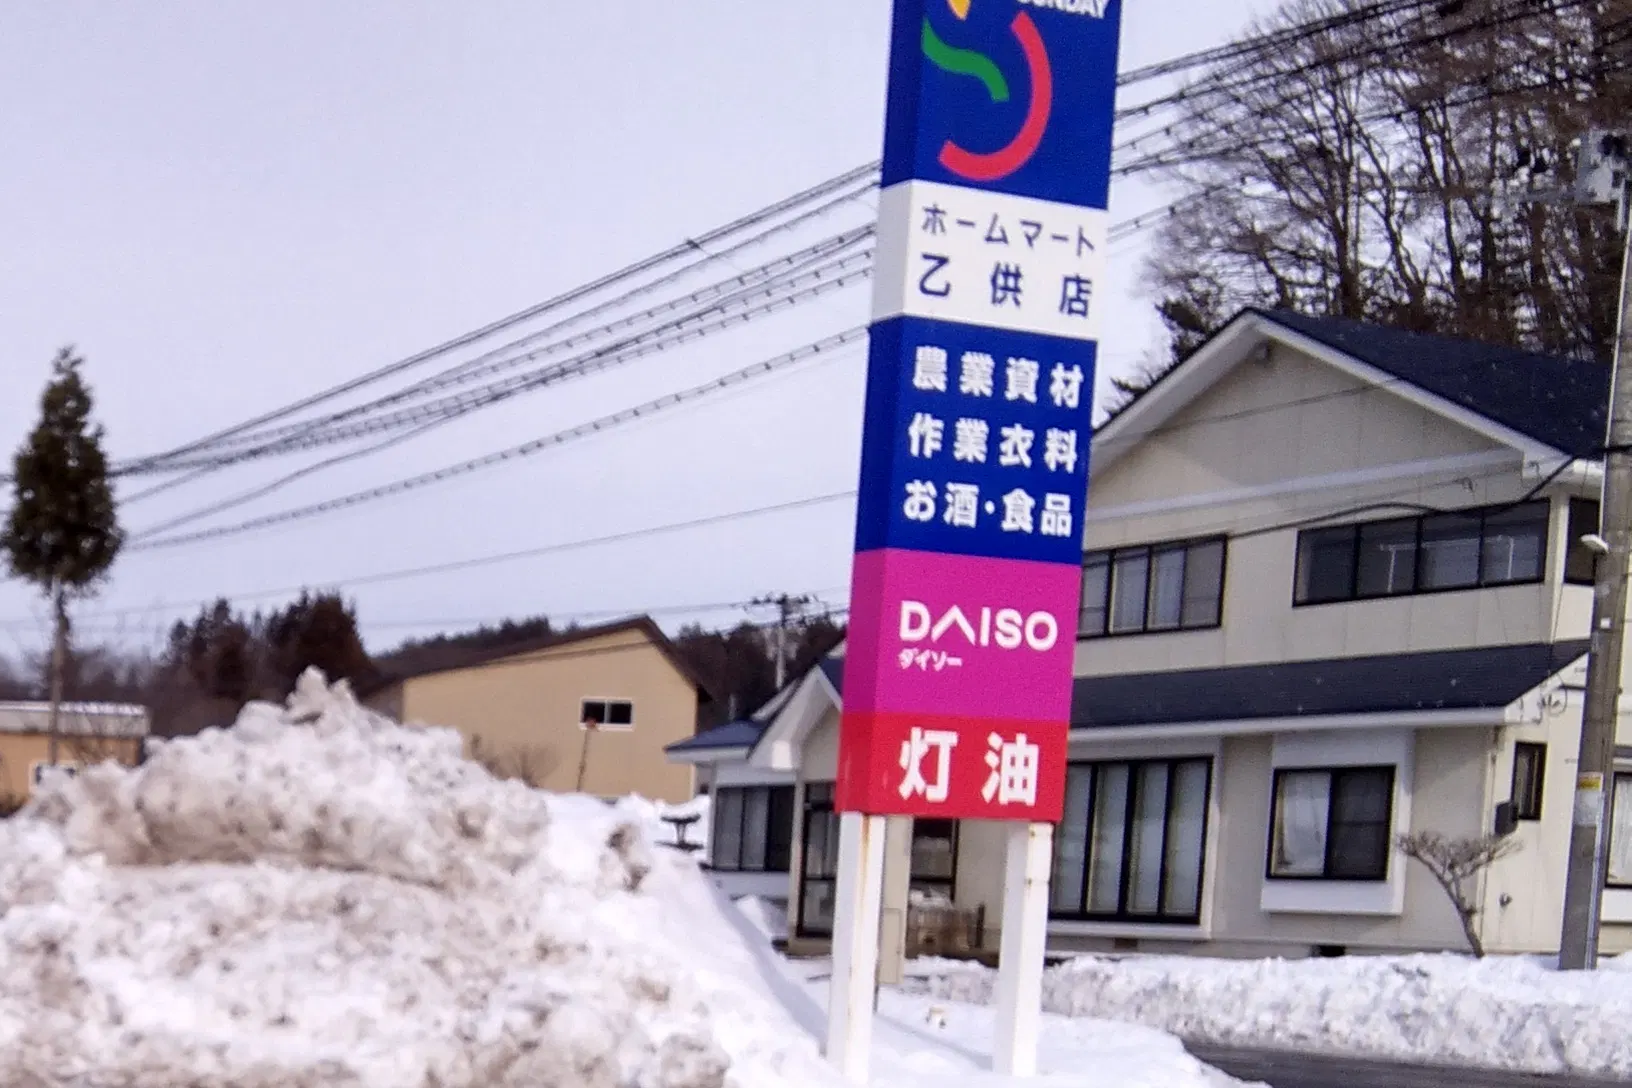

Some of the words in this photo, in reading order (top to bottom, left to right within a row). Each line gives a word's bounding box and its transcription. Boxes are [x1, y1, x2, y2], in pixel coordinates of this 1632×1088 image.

[921, 204, 1095, 257] ホームマート
[918, 253, 1092, 317] 乙供店
[912, 346, 1084, 408] 農業資材
[908, 412, 1078, 473] 作業衣料
[903, 479, 1073, 538] お酒・食品
[899, 600, 1058, 650] DAISO
[898, 648, 962, 671] ダイソー
[898, 726, 1040, 806] 灯油
